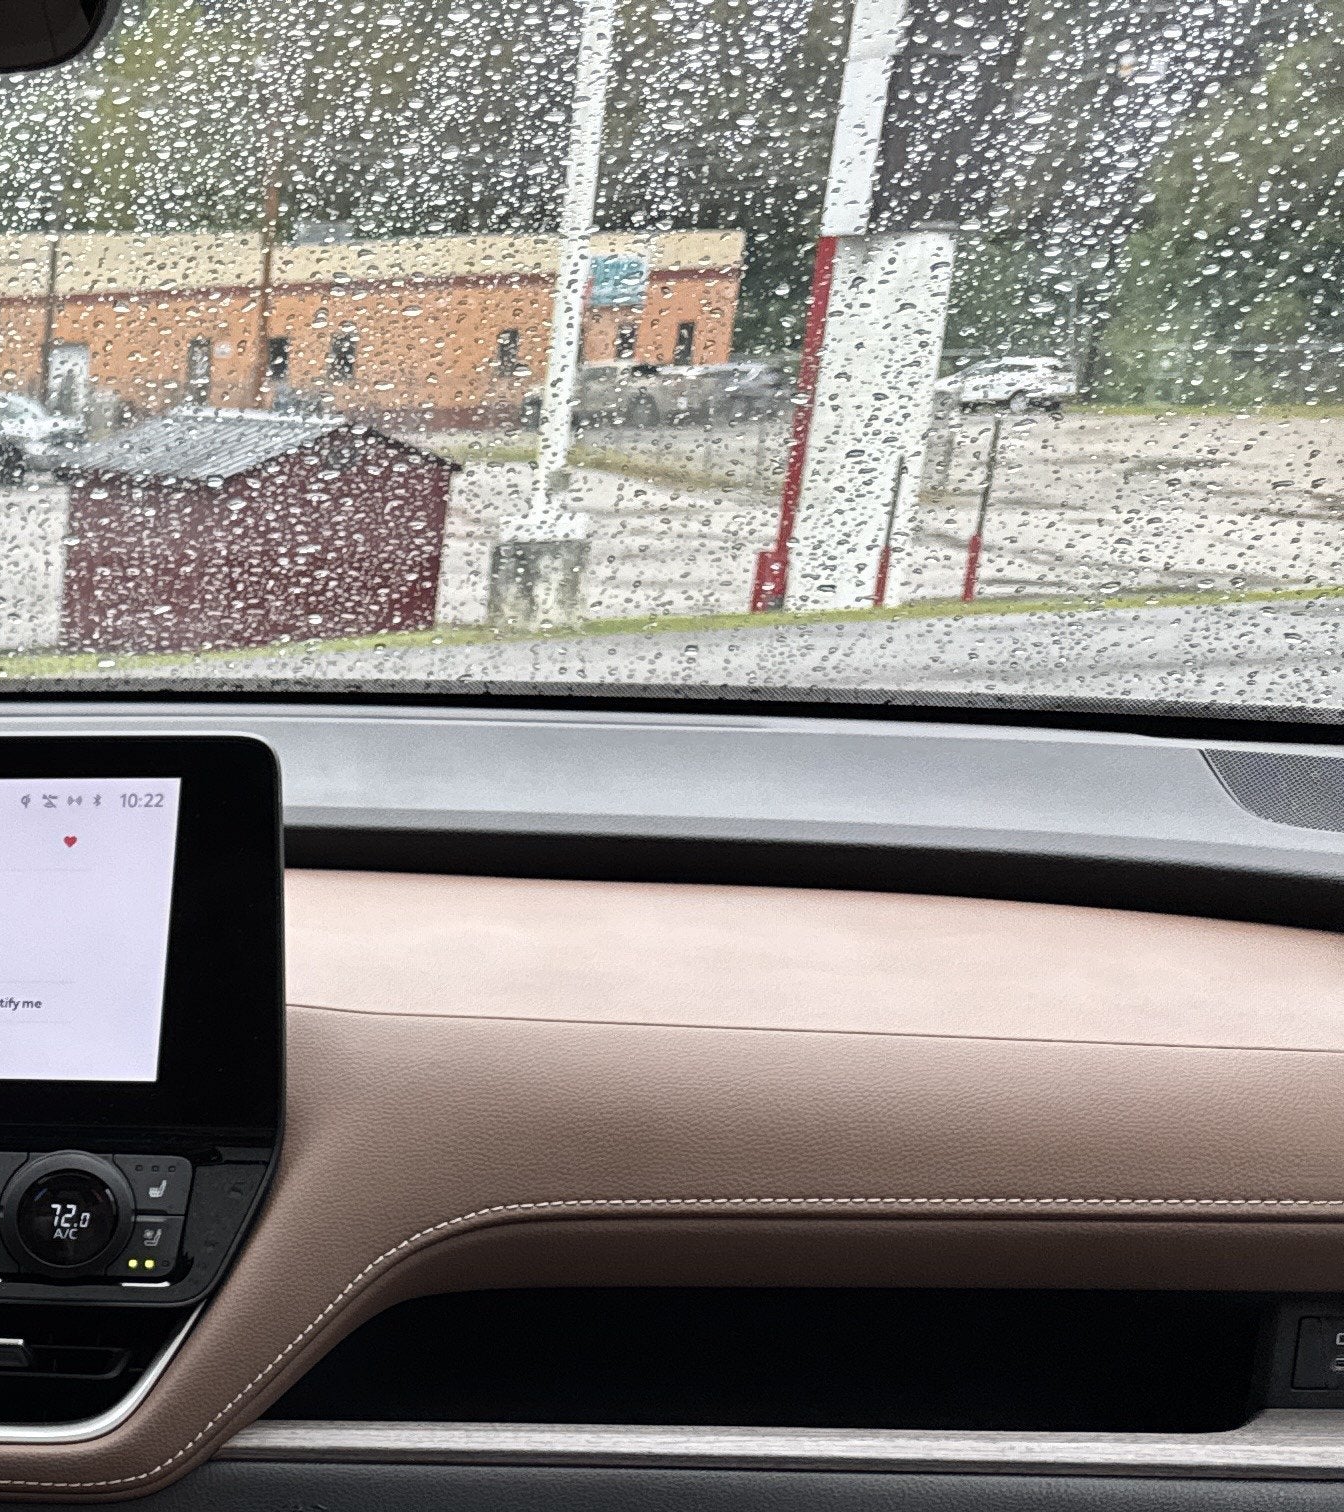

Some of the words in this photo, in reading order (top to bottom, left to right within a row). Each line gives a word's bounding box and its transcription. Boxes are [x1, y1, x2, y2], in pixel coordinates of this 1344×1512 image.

[120, 794, 164, 808] 10:22
[22, 999, 43, 1009] me
[51, 1204, 90, 1229] 72.0
[53, 1227, 78, 1240] A/C
